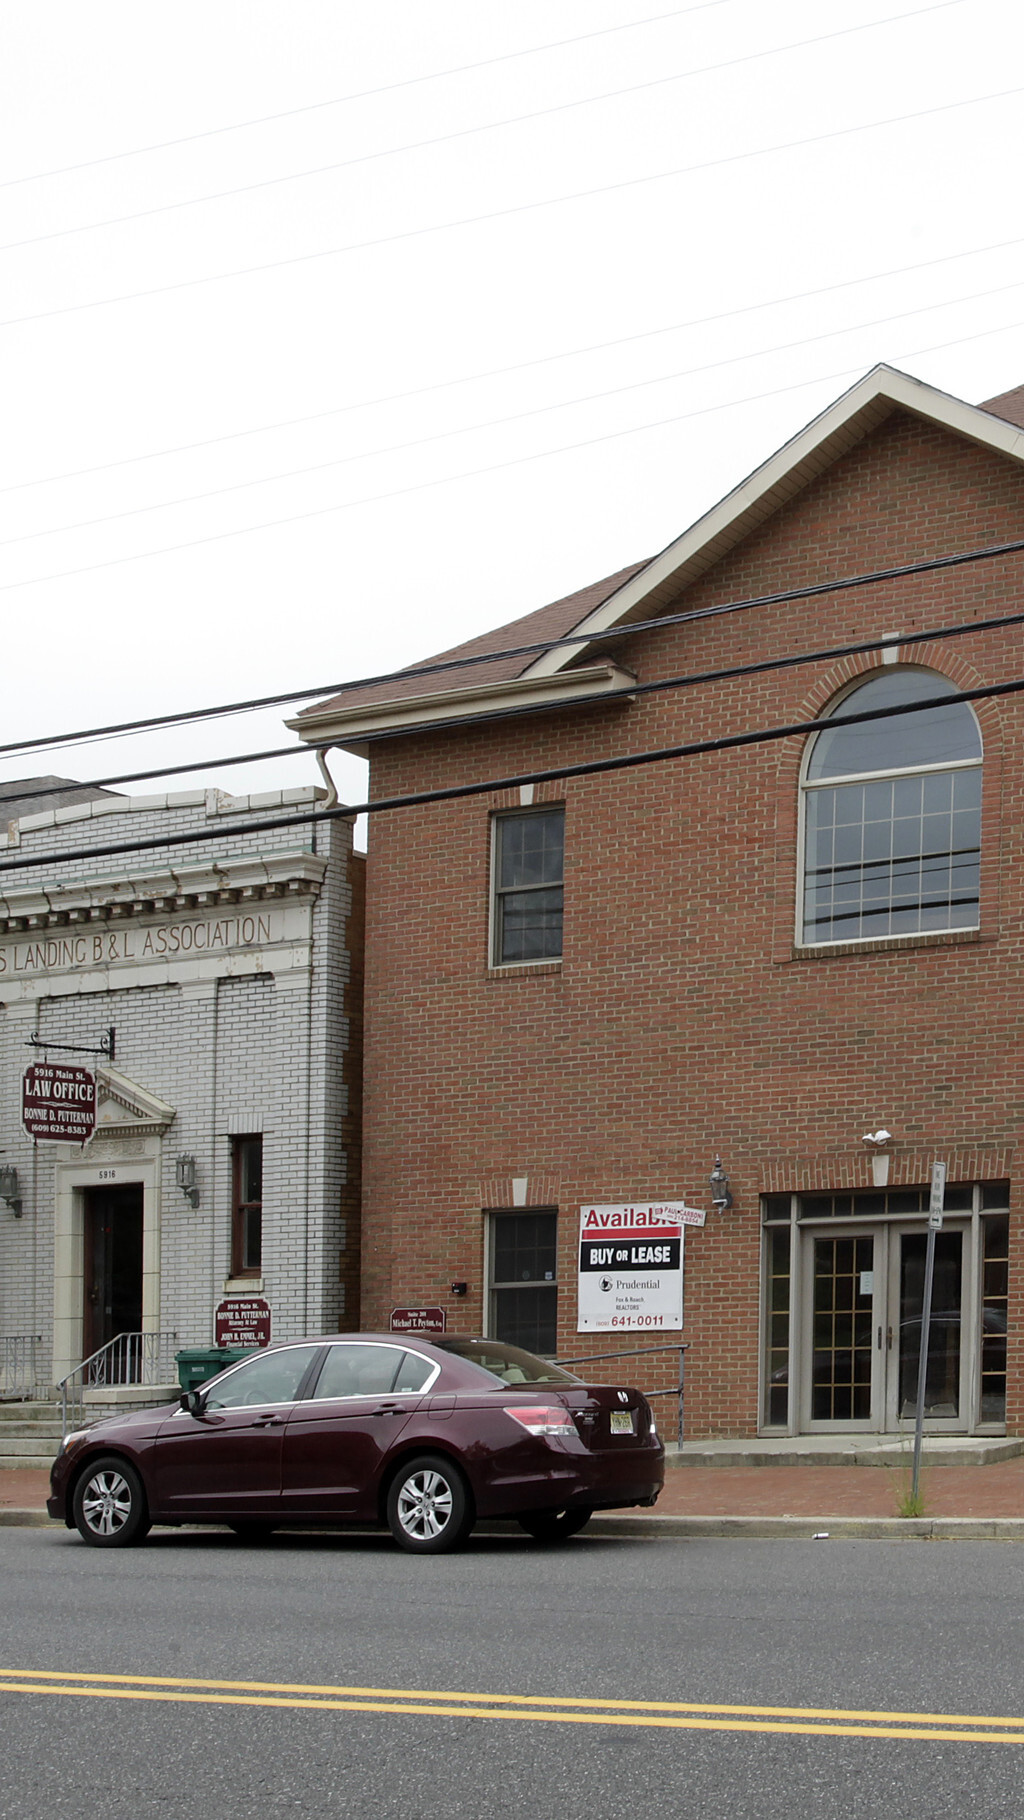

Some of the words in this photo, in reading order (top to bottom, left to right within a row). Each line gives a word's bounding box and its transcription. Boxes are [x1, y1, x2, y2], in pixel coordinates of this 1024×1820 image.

[13, 937, 87, 971] LANDING
[92, 934, 103, 962] B
[107, 932, 121, 960] &
[123, 932, 135, 958] L
[142, 914, 271, 957] ASSOCIATION
[34, 1067, 54, 1078] 5916
[55, 1070, 74, 1080] Main
[75, 1072, 86, 1081] St.
[25, 1078, 52, 1098] LAW
[53, 1081, 94, 1102] OFFICE
[24, 1107, 48, 1121] BONNIE
[49, 1109, 56, 1121] D.
[57, 1110, 94, 1124] PUTTERMAN
[31, 1124, 49, 1132] (609)
[50, 1124, 87, 1135] 625-8383
[98, 1169, 116, 1179] 5916
[586, 1207, 679, 1227] Availab
[590, 1248, 614, 1265] BUY
[616, 1249, 629, 1262] OR
[631, 1246, 671, 1264] LEASE
[616, 1279, 660, 1289] Prudential
[611, 1315, 664, 1327] 641-0011
